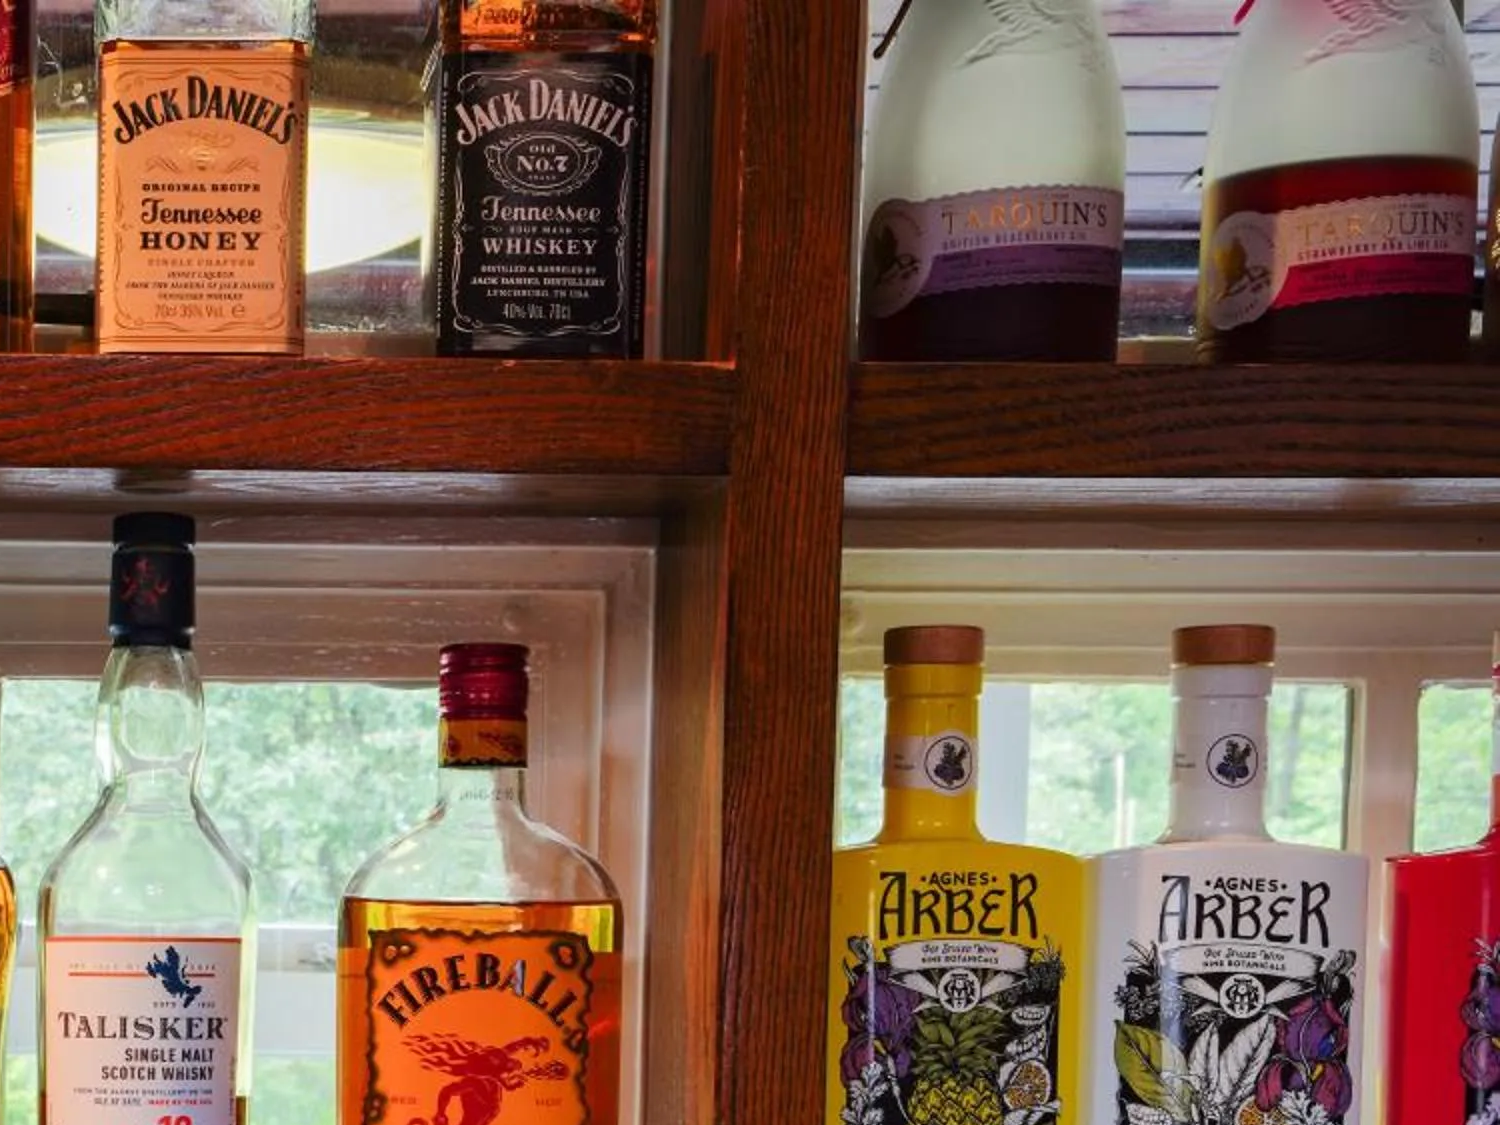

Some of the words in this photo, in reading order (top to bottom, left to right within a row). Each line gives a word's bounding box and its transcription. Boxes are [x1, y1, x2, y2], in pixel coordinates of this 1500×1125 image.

[111, 86, 184, 145] JACK
[186, 74, 300, 146] DANIEL'S
[455, 88, 525, 146] JACK
[528, 77, 639, 148] DANIEL'S
[528, 143, 557, 154] Old
[140, 197, 263, 225] Tennessee
[479, 195, 602, 223] Tennessee
[940, 199, 1108, 235] TARQUIN'S
[139, 231, 262, 252] HONEY
[482, 236, 599, 256] WHISKEY
[929, 871, 990, 887] AGNES
[1213, 876, 1279, 893] AGNES
[878, 870, 1039, 941] ARBER
[1158, 874, 1331, 948] ARBER
[377, 952, 579, 1029] FIREBALL
[57, 1011, 225, 1041] TALISKER
[124, 1048, 177, 1063] SINGLE
[181, 1048, 215, 1062] MALT
[101, 1066, 156, 1082] SCOTCH
[161, 1066, 215, 1082] WHISKY
